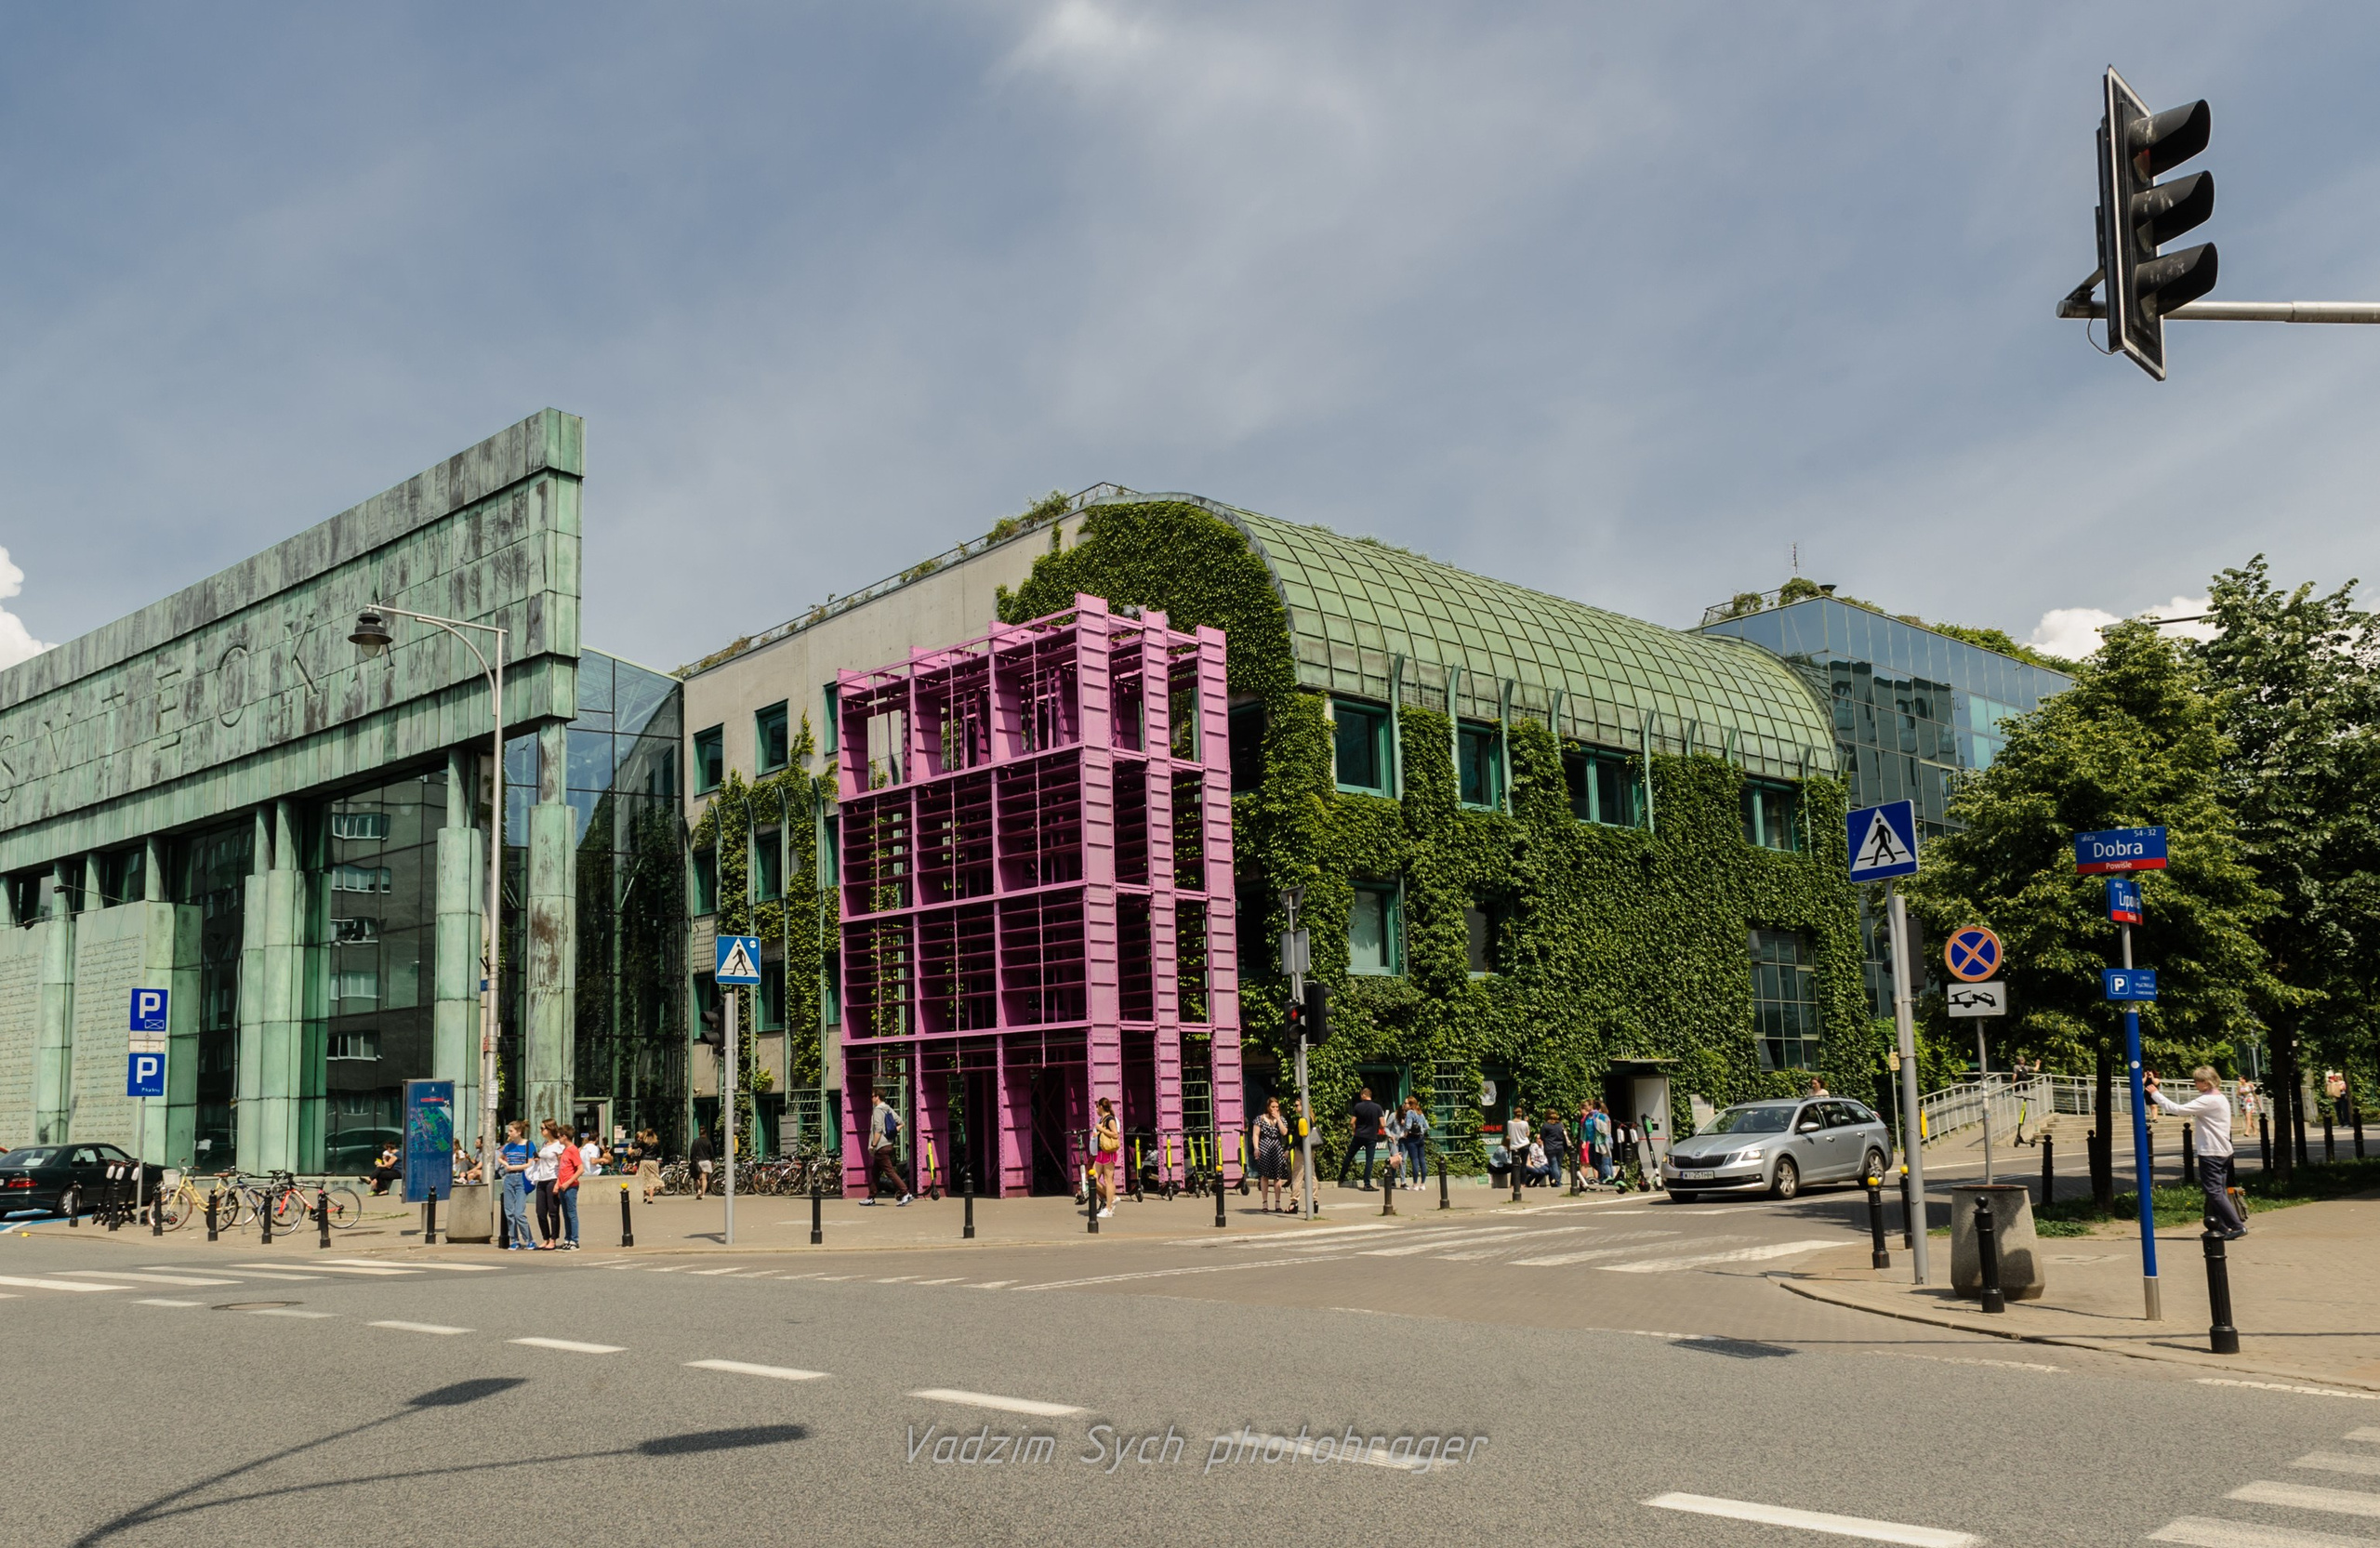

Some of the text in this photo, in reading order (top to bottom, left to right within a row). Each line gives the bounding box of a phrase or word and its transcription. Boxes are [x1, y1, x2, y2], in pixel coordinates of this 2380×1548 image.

[2093, 840, 2143, 858] Dobra
[2114, 977, 2125, 992] P
[139, 992, 161, 1019] P
[137, 1057, 158, 1084] P
